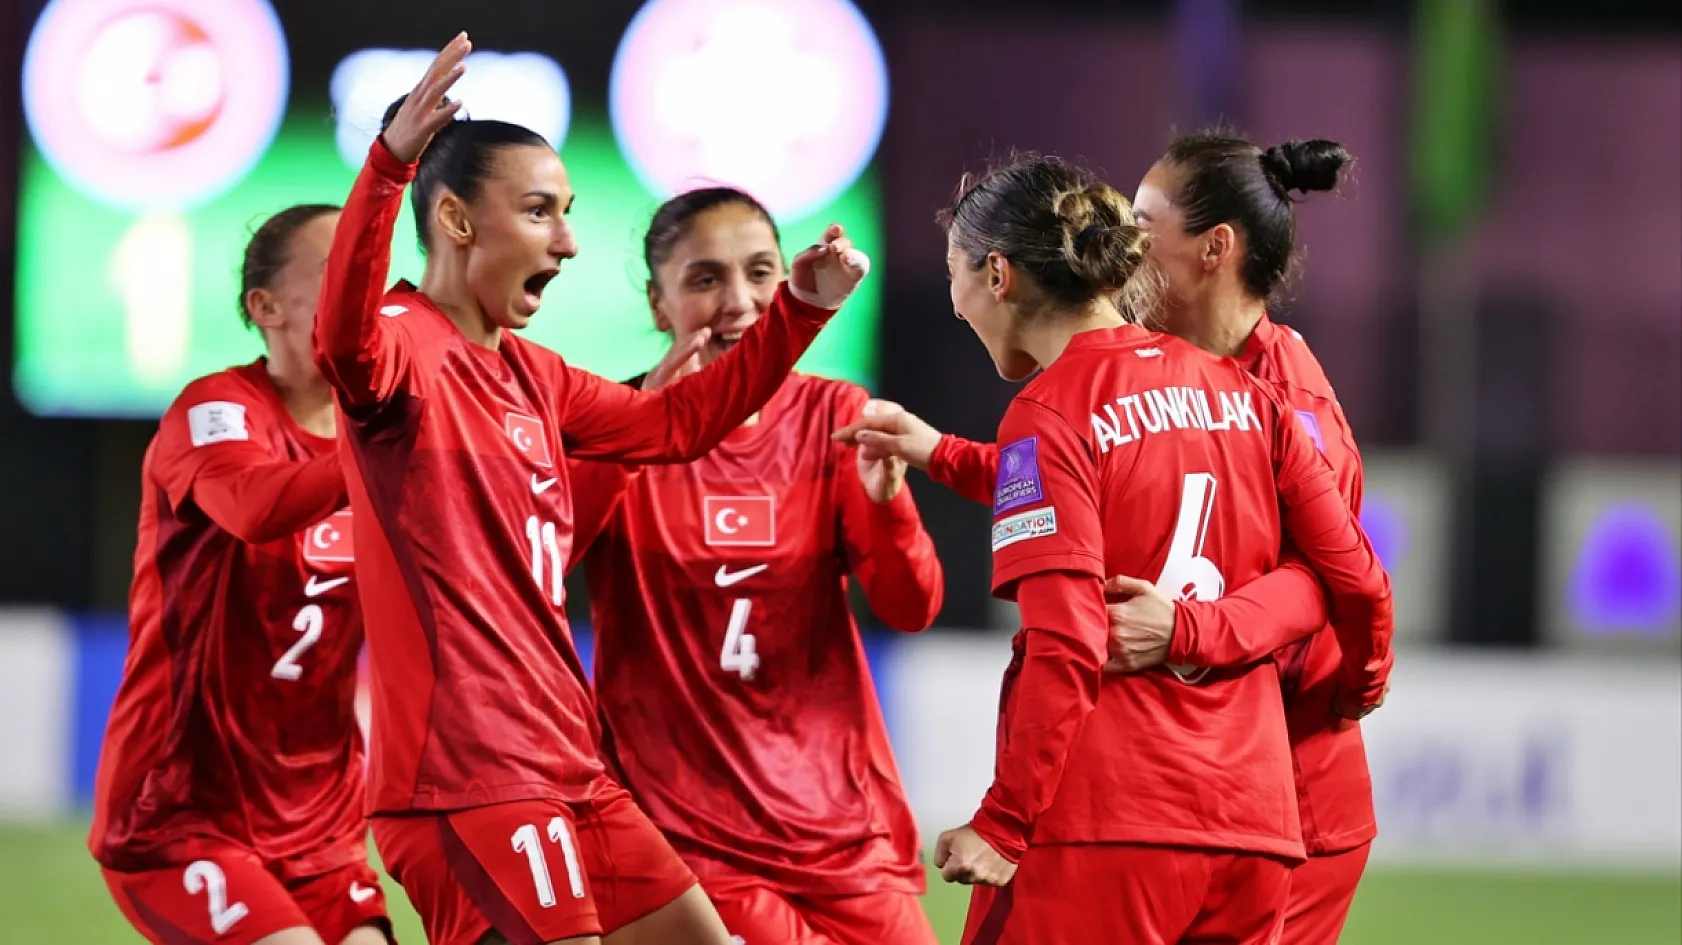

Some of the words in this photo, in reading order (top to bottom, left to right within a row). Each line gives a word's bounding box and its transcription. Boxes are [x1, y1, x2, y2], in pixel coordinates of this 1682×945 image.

[106, 213, 192, 386] 1
[997, 479, 1035, 498] EUROPEAN
[526, 515, 563, 606] 11
[1152, 472, 1226, 684] 6
[270, 604, 324, 681] 2
[719, 598, 759, 680] 4
[183, 860, 249, 934] 2
[510, 816, 585, 909] 11
